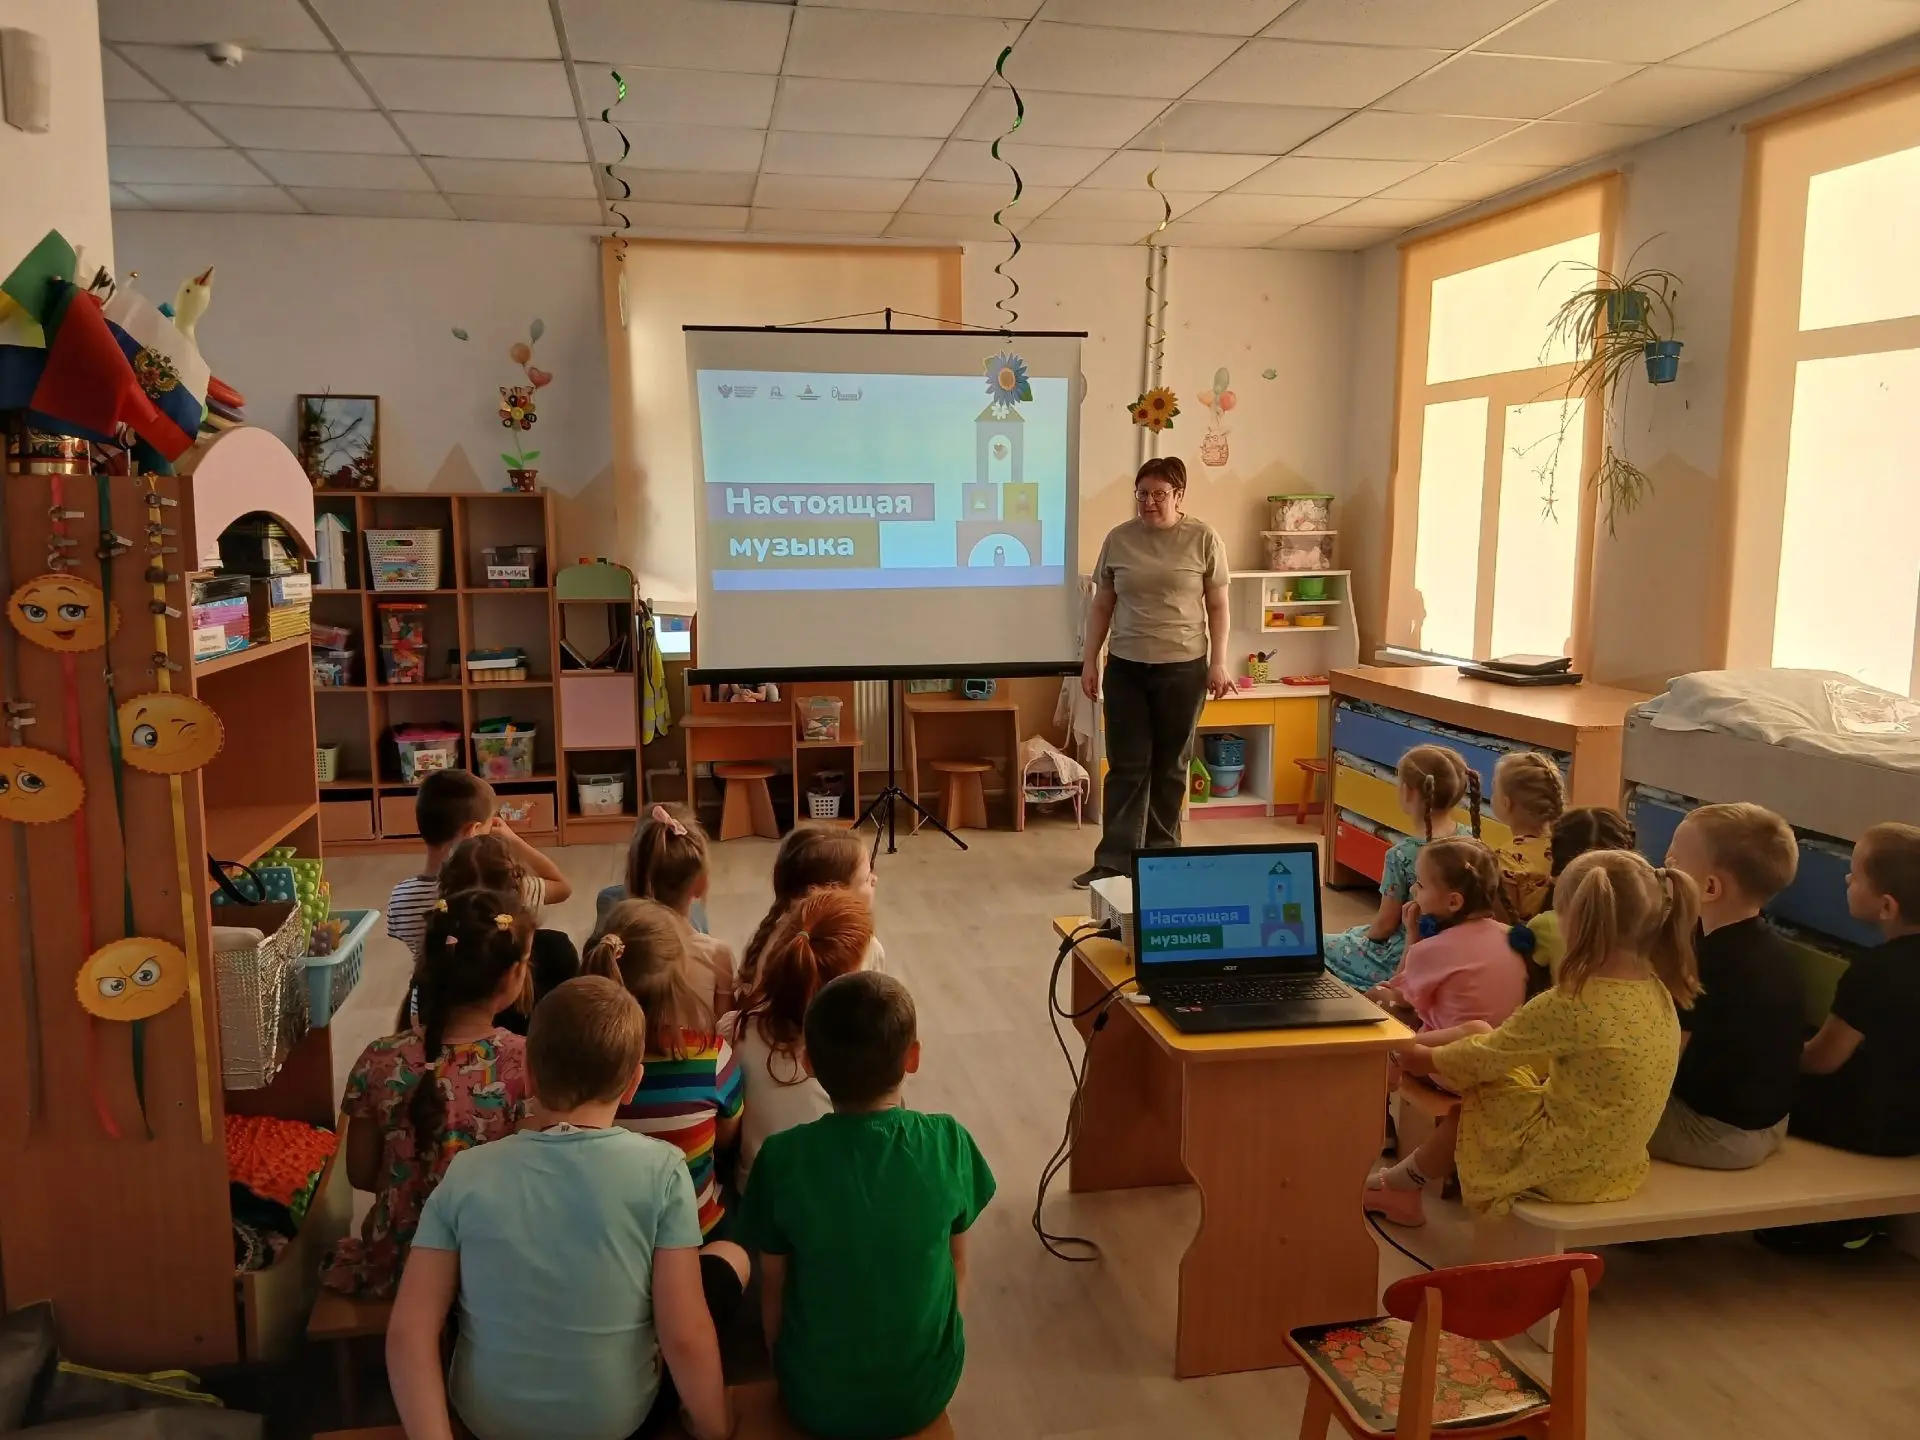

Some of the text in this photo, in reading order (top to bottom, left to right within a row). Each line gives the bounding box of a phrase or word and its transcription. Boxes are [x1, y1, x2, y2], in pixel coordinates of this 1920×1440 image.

[726, 488, 912, 517] Настоящая
[729, 537, 854, 562] музыка
[1149, 911, 1239, 924] Настоящая
[1150, 933, 1211, 947] музыка
